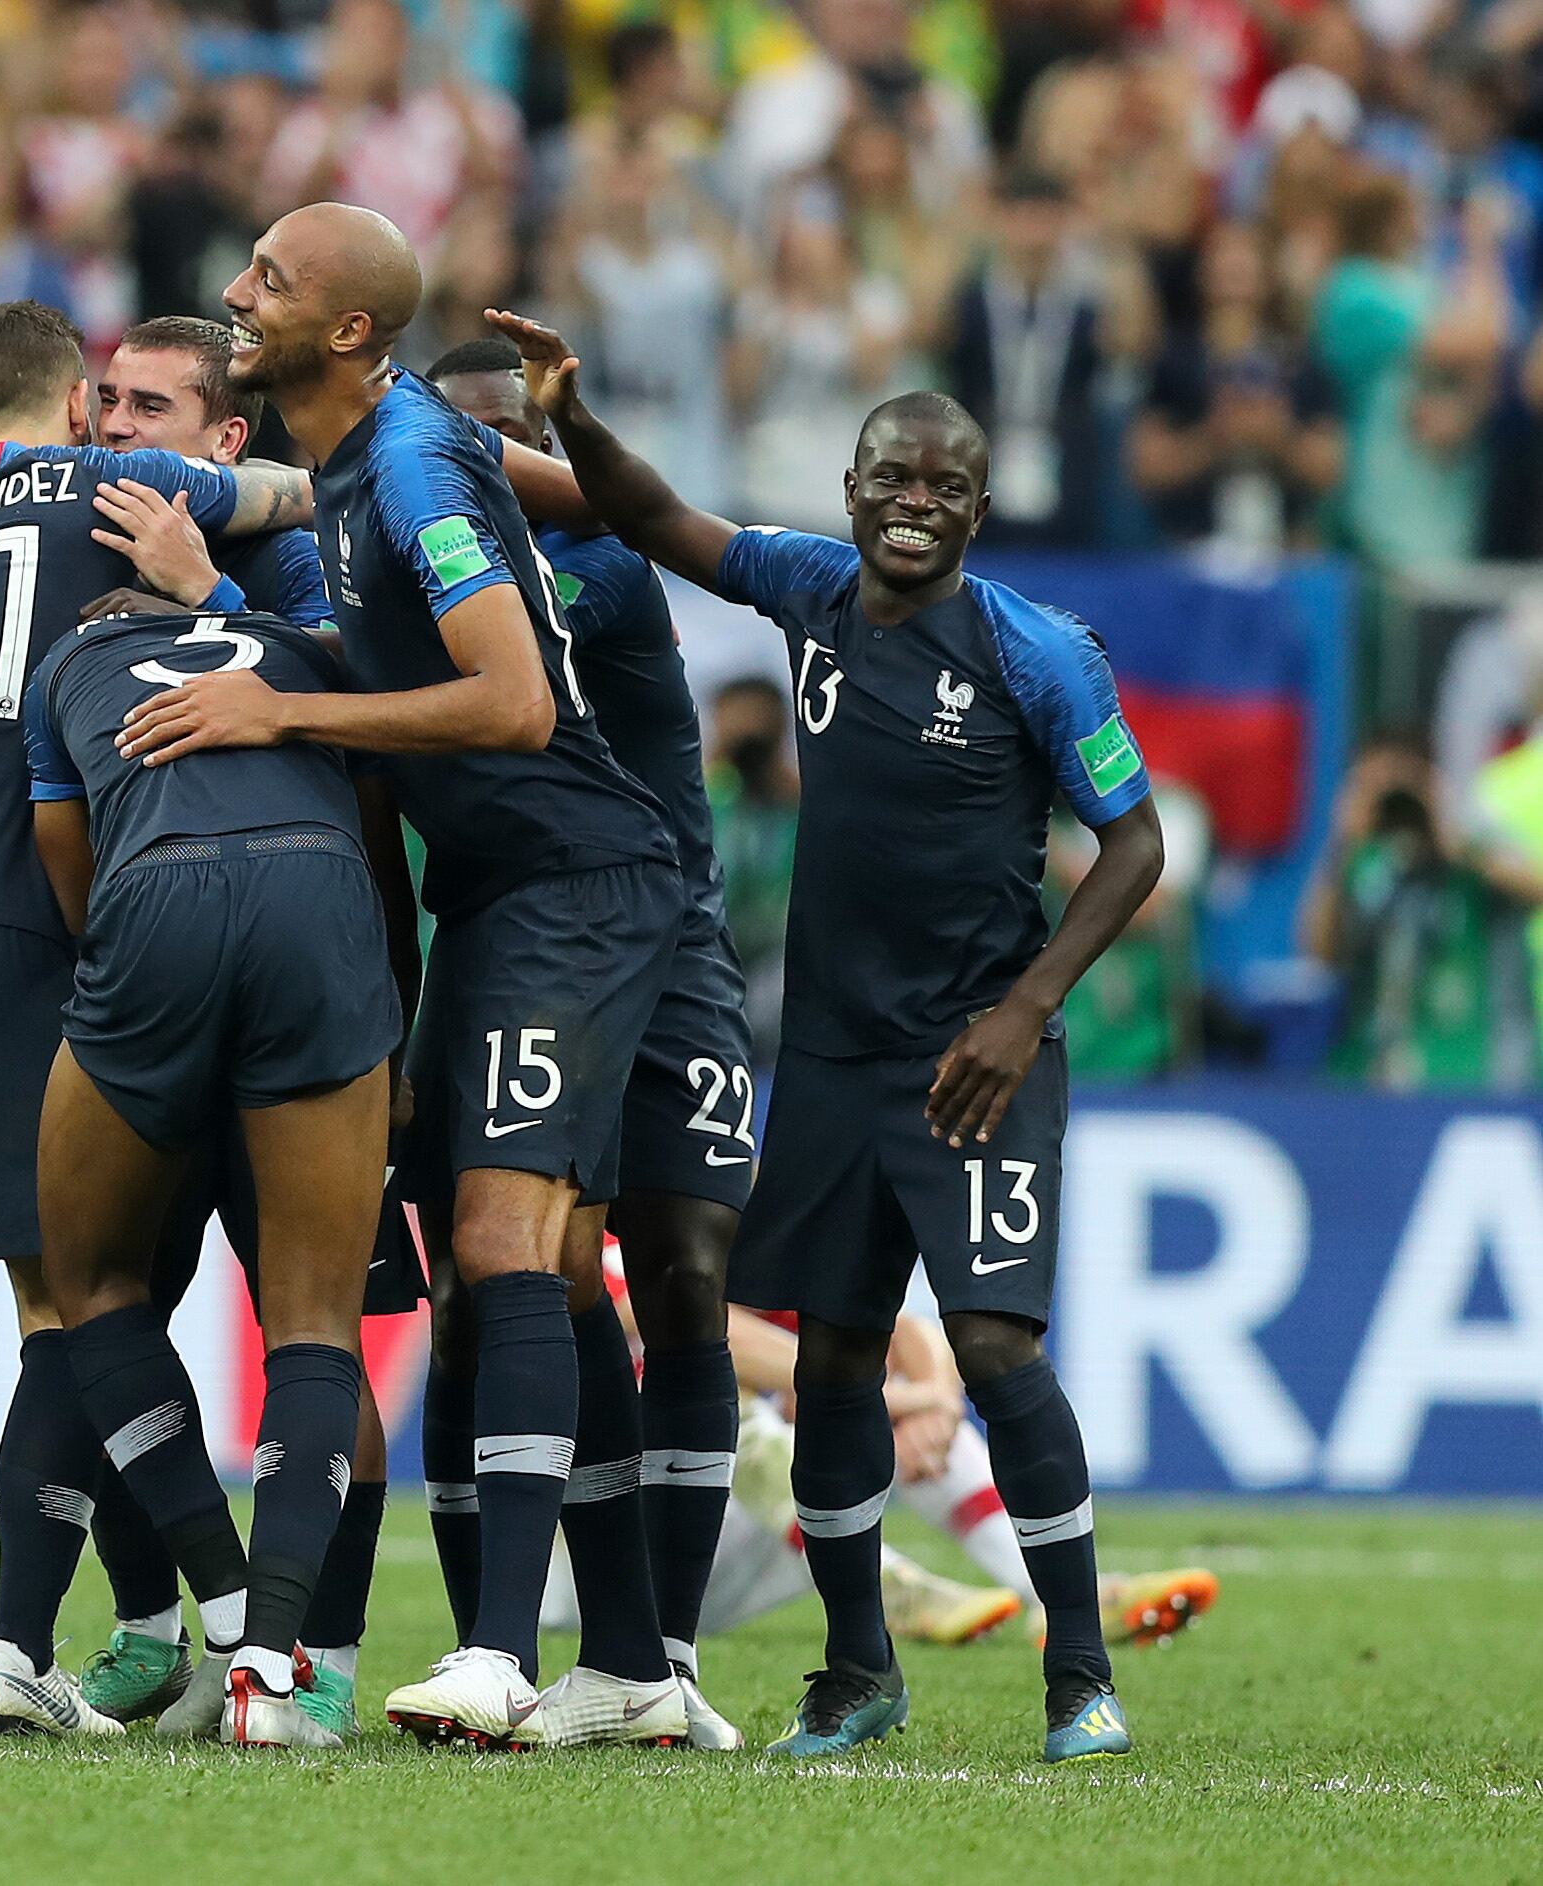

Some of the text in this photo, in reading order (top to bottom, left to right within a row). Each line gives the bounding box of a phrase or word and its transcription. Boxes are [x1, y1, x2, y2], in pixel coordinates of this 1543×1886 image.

[798, 637, 845, 735] 13
[486, 1028, 563, 1111] 15
[686, 1057, 755, 1151] 22
[964, 1159, 1040, 1244] 13
[1056, 1110, 1543, 1490] RA
